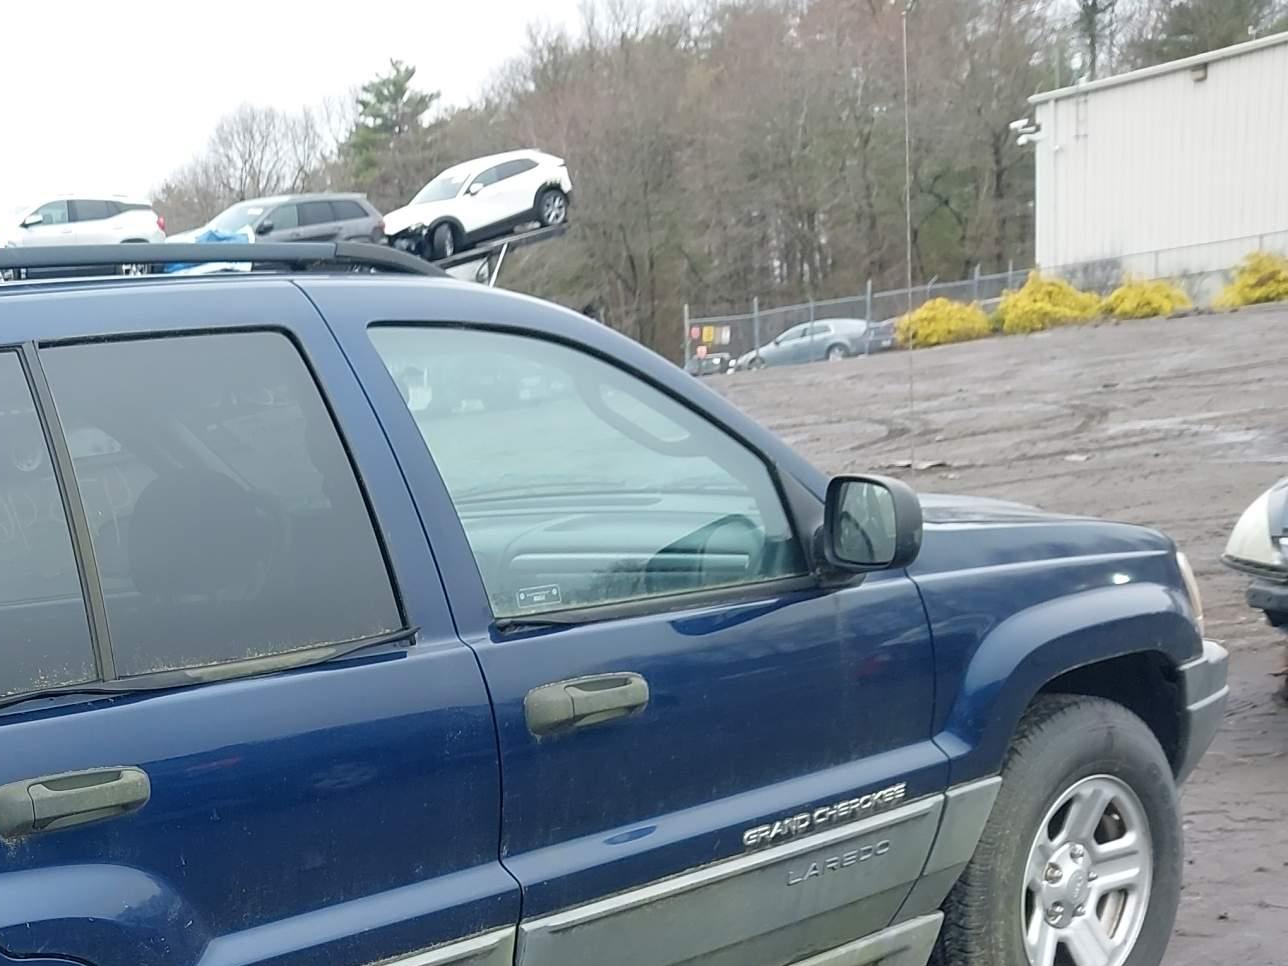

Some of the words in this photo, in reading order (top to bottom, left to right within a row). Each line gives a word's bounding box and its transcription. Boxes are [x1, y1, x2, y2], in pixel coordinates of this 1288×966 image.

[743, 813, 811, 846] GRAND
[814, 782, 906, 824] CHEROKEE
[787, 840, 890, 886] LAREDO
